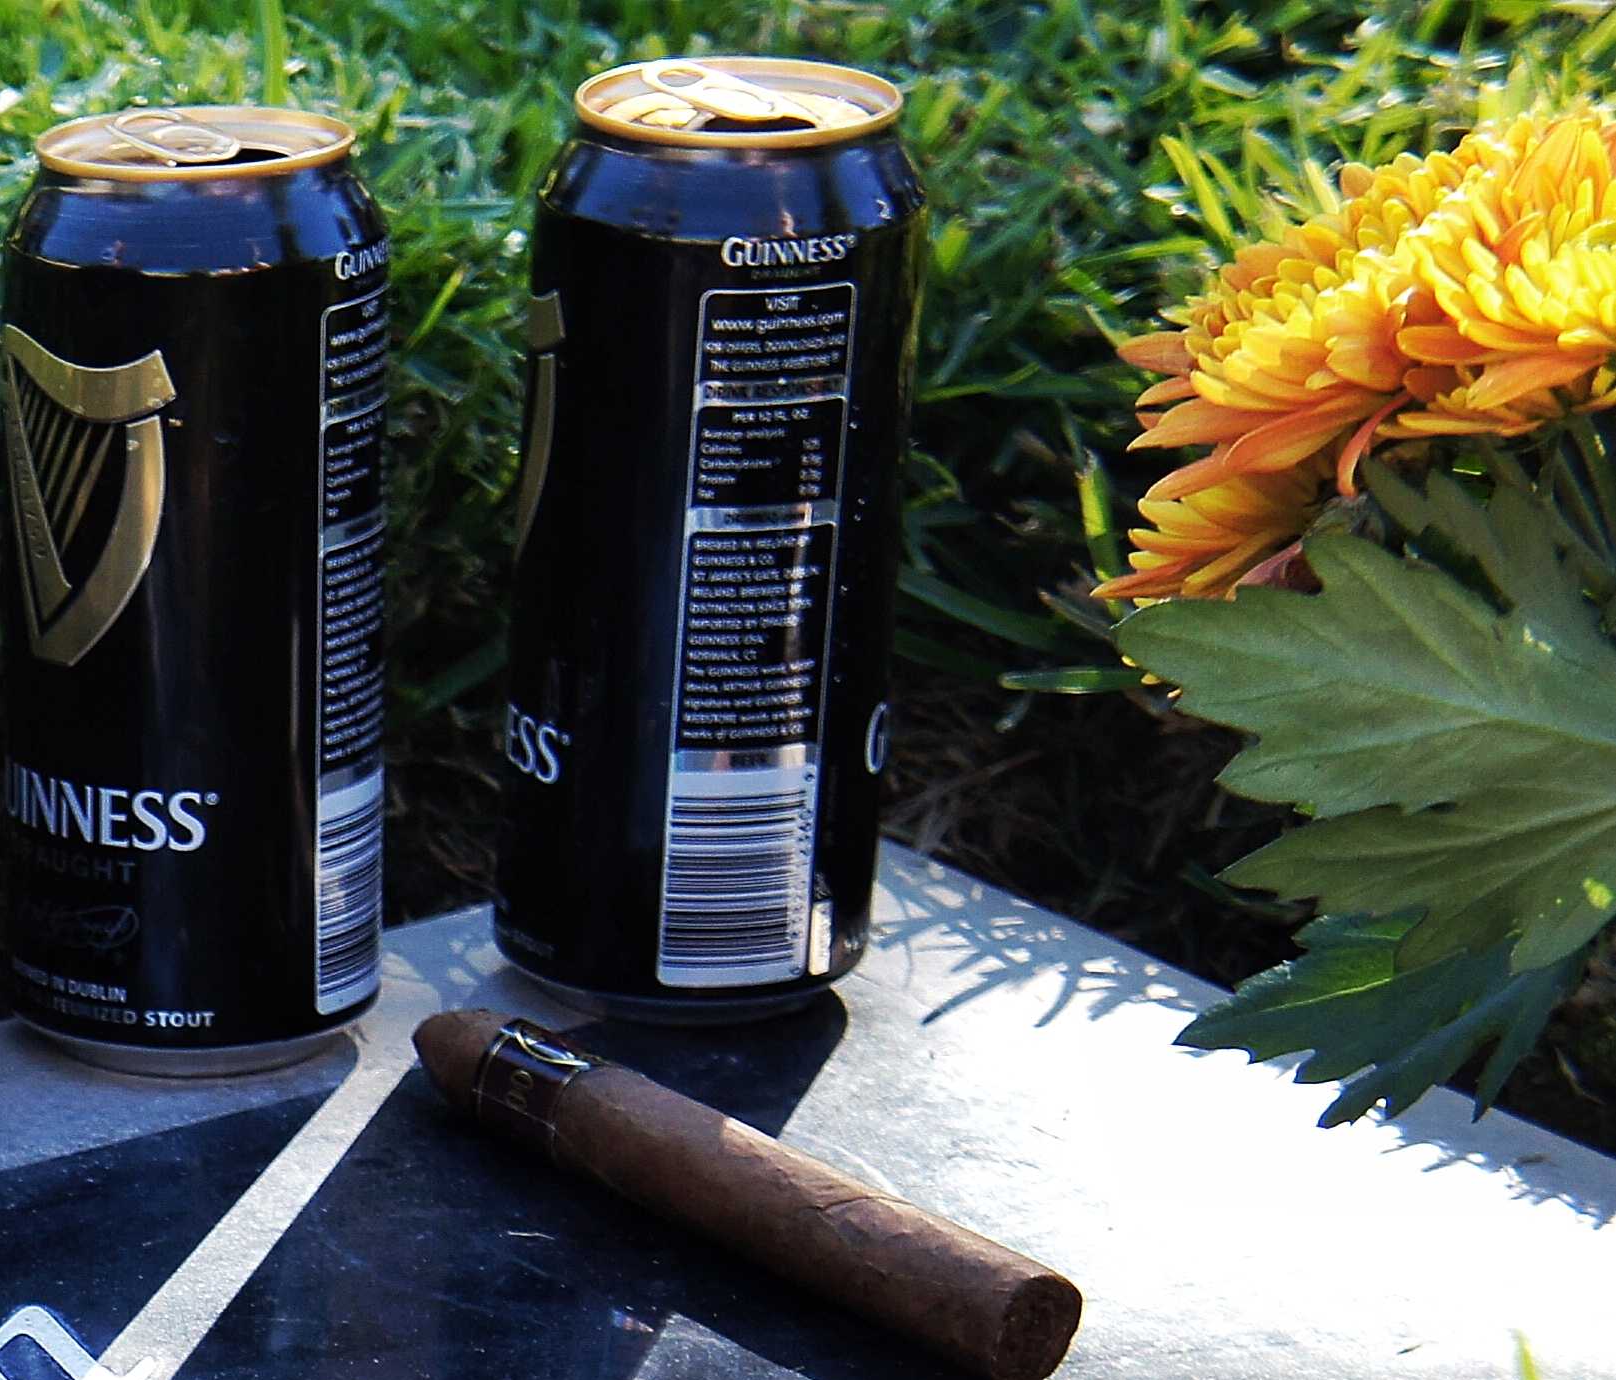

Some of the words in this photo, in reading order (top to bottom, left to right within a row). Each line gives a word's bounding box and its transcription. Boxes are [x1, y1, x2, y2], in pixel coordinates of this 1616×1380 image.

[721, 236, 847, 267] GUINNESS
[69, 978, 127, 1003] DUBLIN
[145, 1010, 215, 1028] STOUT
